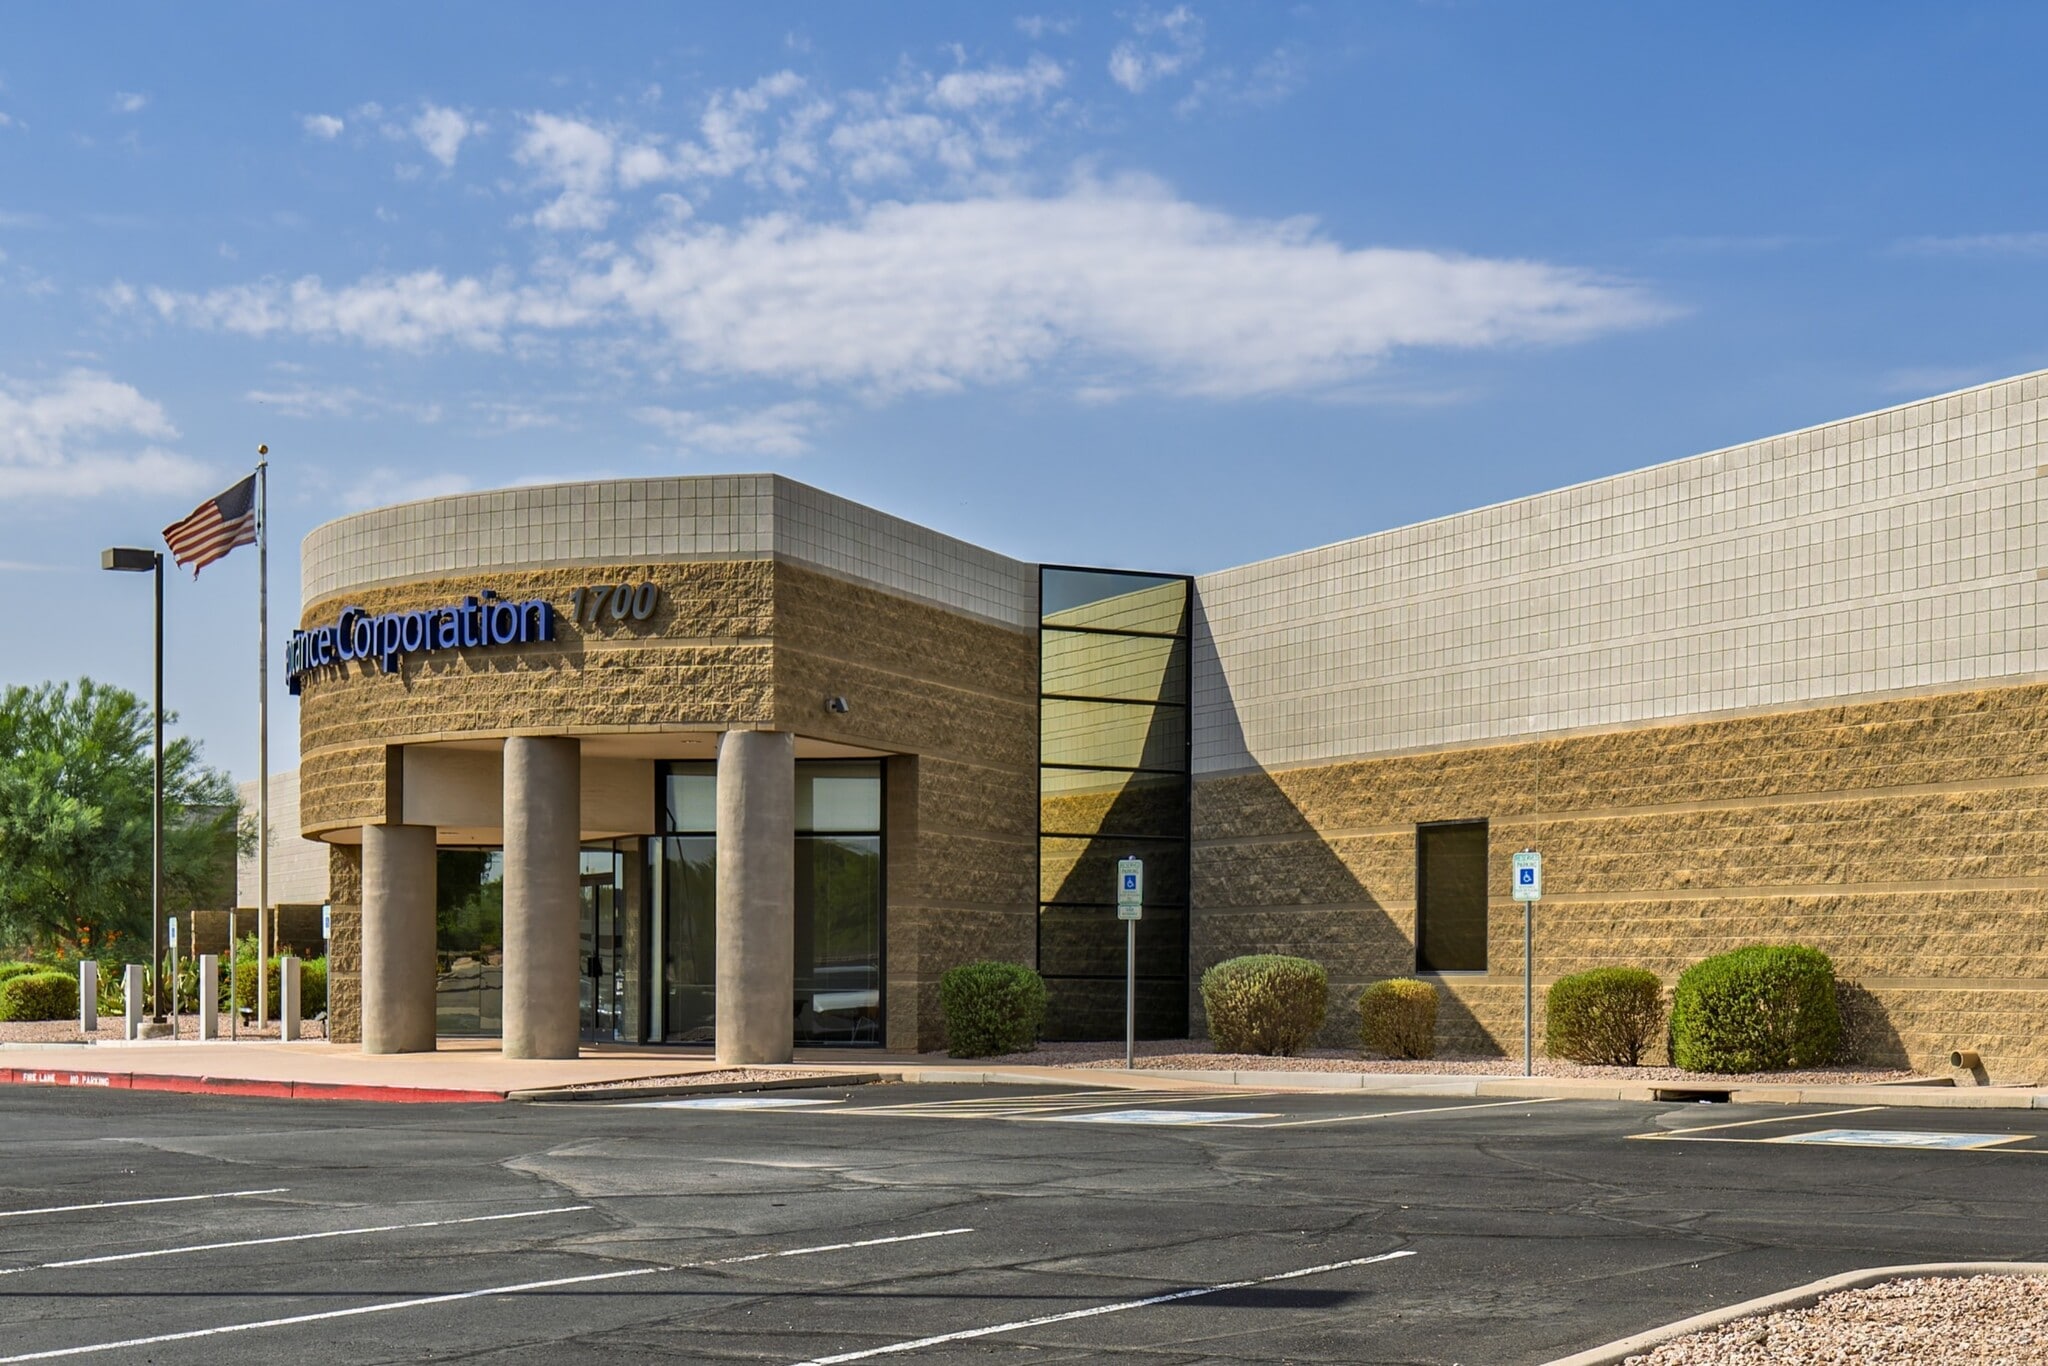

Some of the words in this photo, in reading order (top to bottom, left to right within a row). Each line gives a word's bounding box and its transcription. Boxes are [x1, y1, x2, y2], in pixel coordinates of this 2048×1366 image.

[570, 582, 659, 622] 1700
[336, 590, 555, 673] Corporation
[23, 1072, 37, 1082] FIRE
[40, 1073, 56, 1083] LANE
[69, 1075, 79, 1085] NO
[82, 1075, 110, 1087] PARKING
